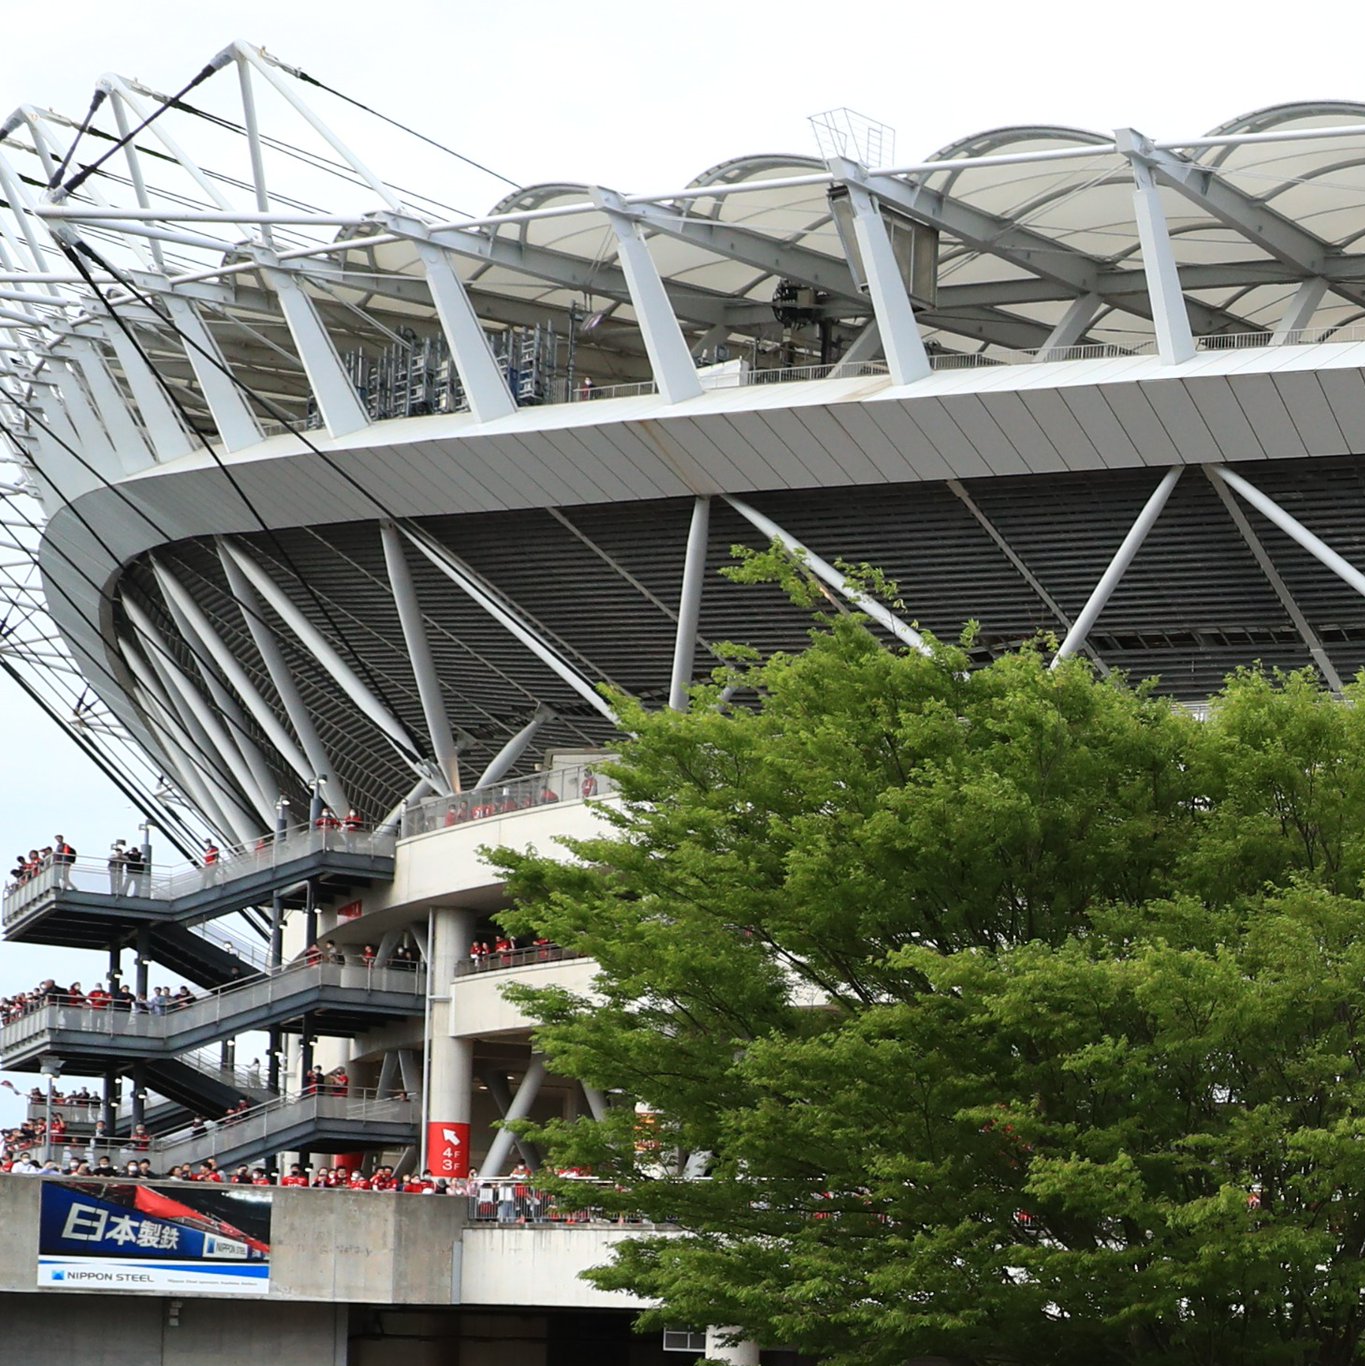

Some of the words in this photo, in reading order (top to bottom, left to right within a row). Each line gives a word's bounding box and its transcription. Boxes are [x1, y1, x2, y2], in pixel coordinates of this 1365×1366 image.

[442, 1159, 460, 1170] 3F
[61, 1202, 180, 1251] 日本製鉄
[67, 1271, 113, 1281] NIPPON
[116, 1273, 155, 1283] STEEL
